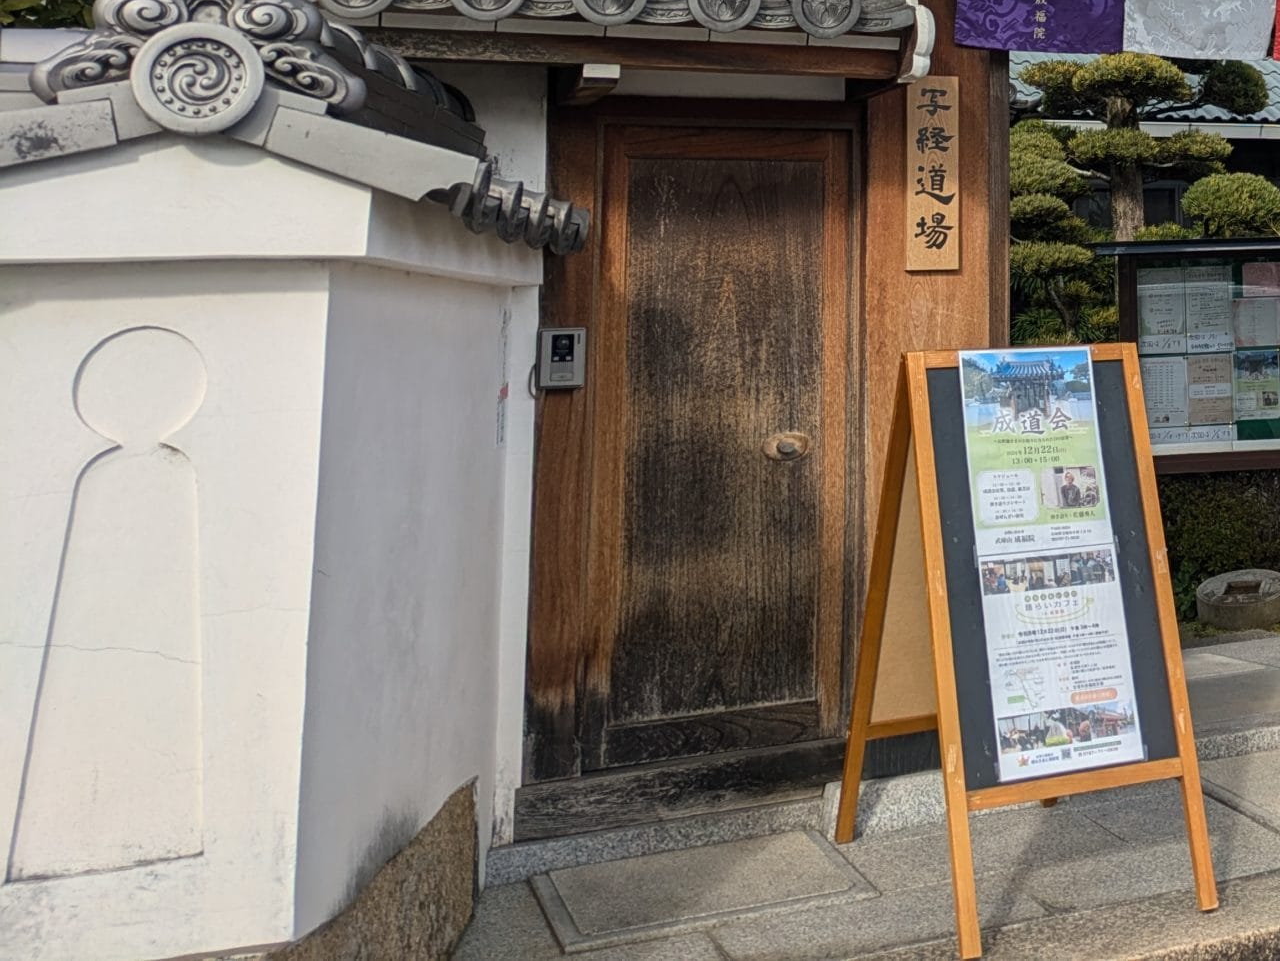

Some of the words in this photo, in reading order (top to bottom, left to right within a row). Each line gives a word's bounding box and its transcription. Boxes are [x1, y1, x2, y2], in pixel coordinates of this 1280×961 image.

[914, 87, 956, 250] 写経道場
[992, 406, 1072, 435] 成道会
